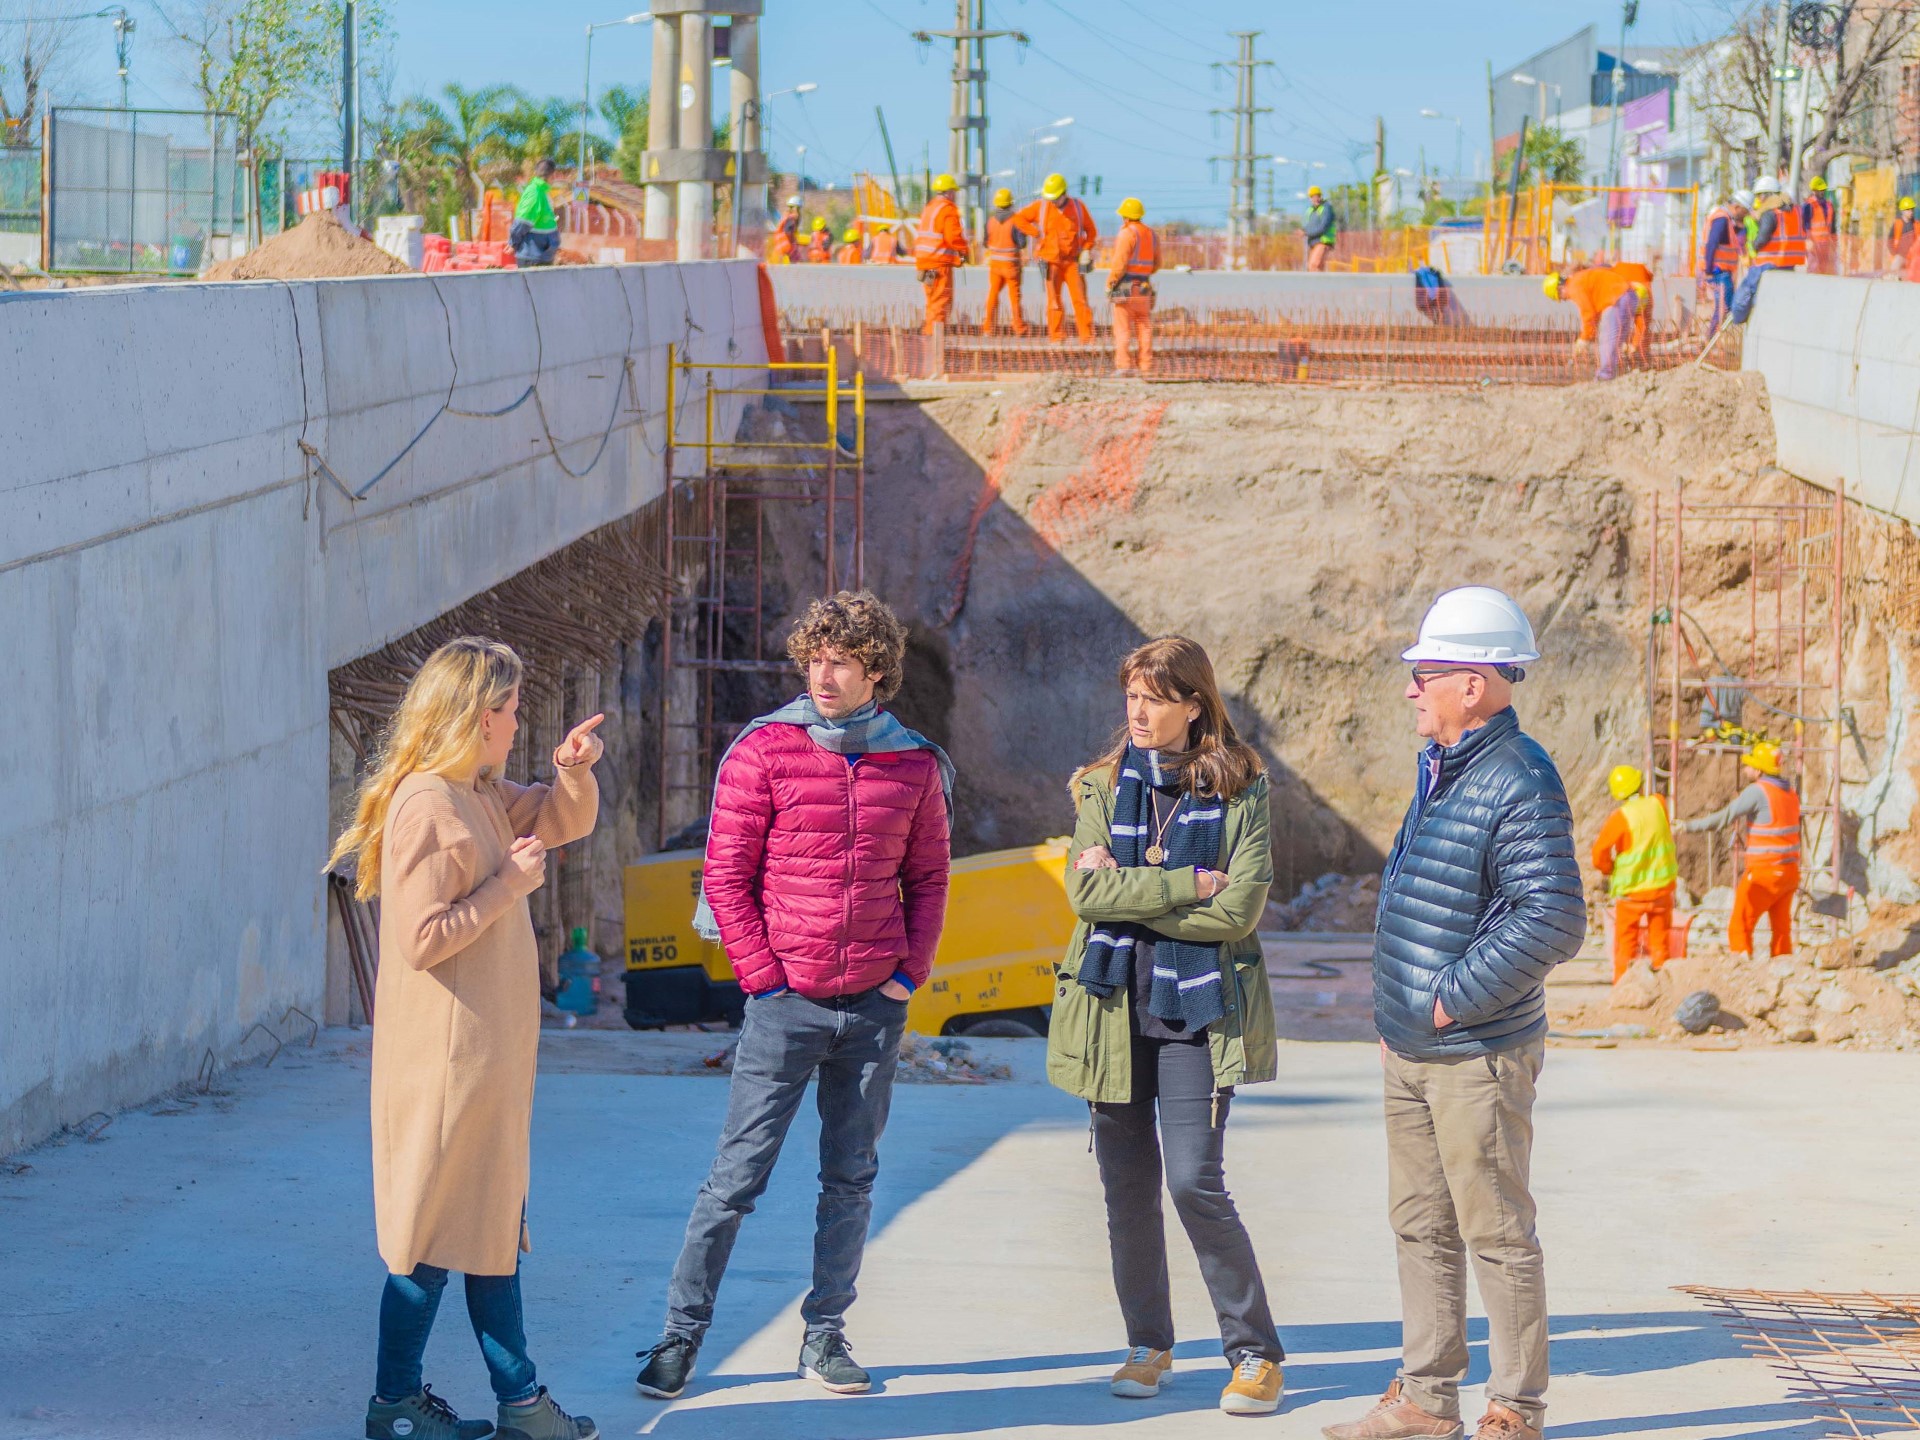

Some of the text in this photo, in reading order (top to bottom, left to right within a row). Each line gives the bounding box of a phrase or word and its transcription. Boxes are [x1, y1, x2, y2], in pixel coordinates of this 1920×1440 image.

[630, 935, 677, 945] MOBILAIR
[631, 945, 677, 963] M 50
